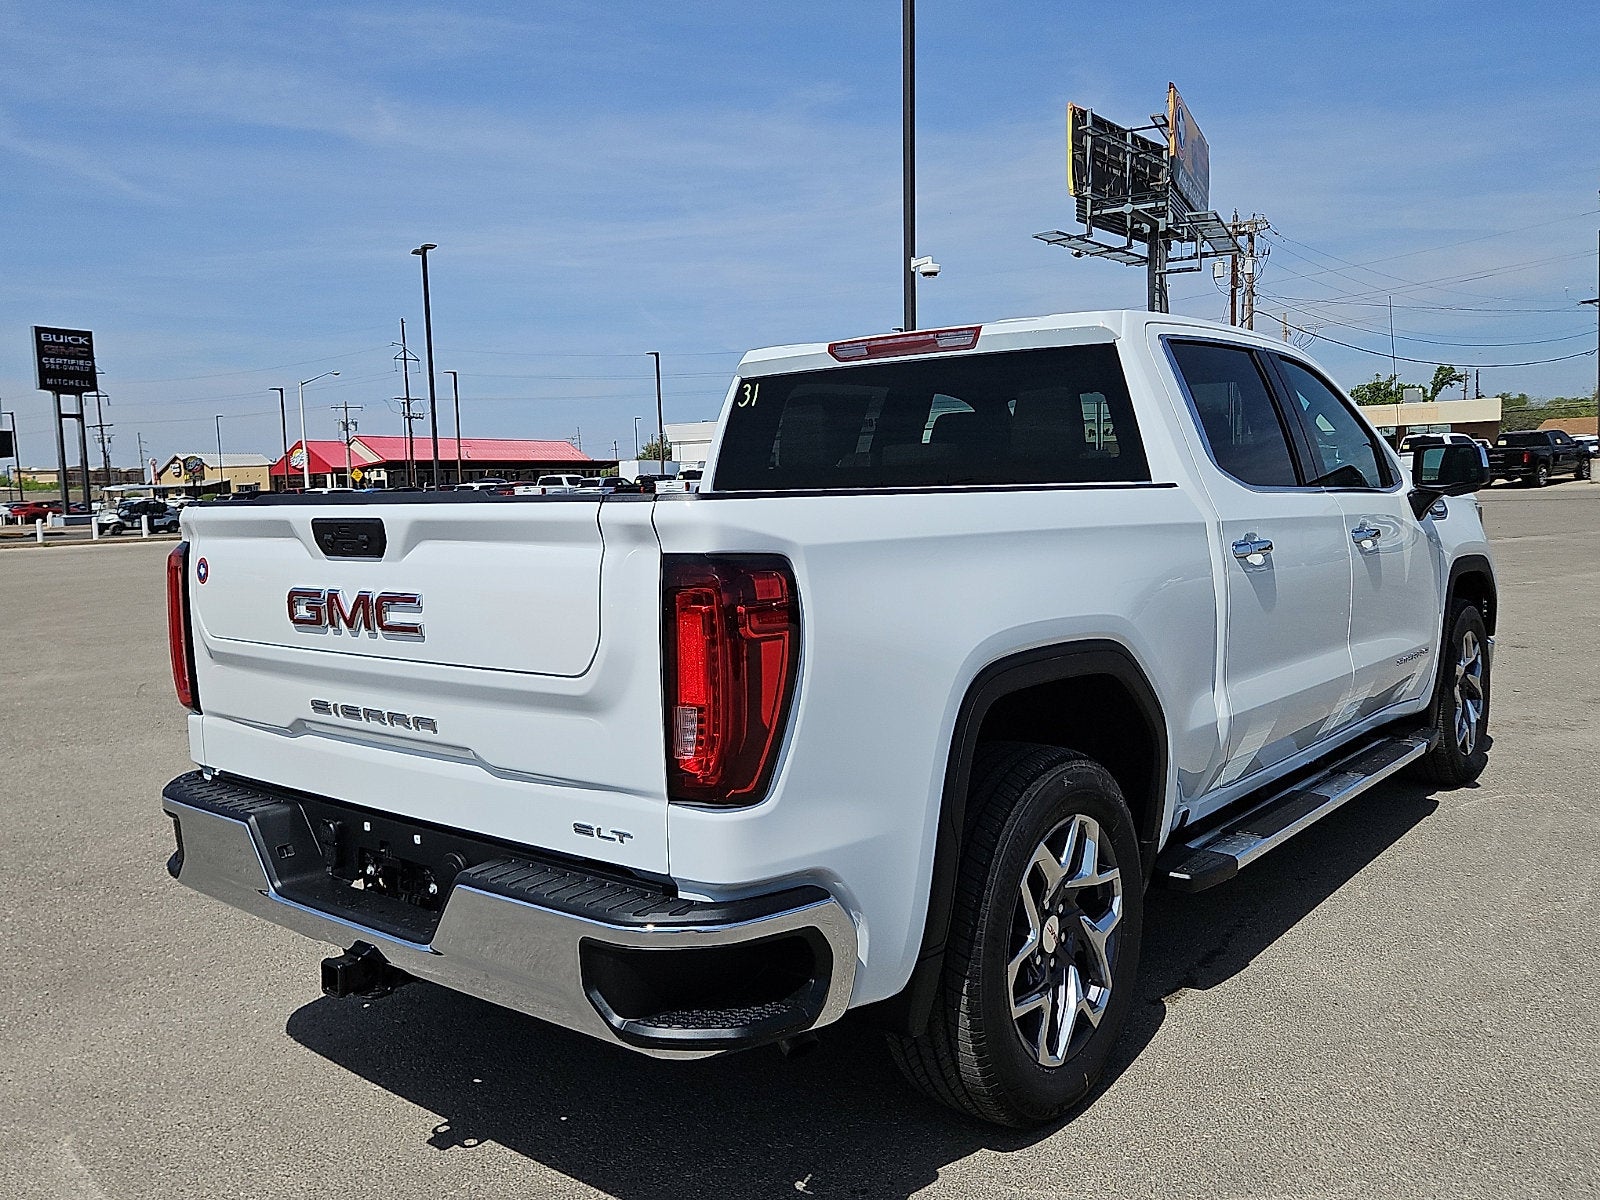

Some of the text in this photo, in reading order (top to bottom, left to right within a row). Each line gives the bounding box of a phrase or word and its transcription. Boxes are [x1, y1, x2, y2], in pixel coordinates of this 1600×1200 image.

[41, 333, 90, 345] BUICK
[42, 357, 92, 366] CERTIFIED
[45, 363, 91, 372] PRE-OWNED
[46, 377, 91, 387] MITCHELL
[737, 382, 760, 408] 31
[286, 586, 426, 643] GMC
[310, 698, 438, 735] SIERRA
[572, 822, 634, 845] SLT
